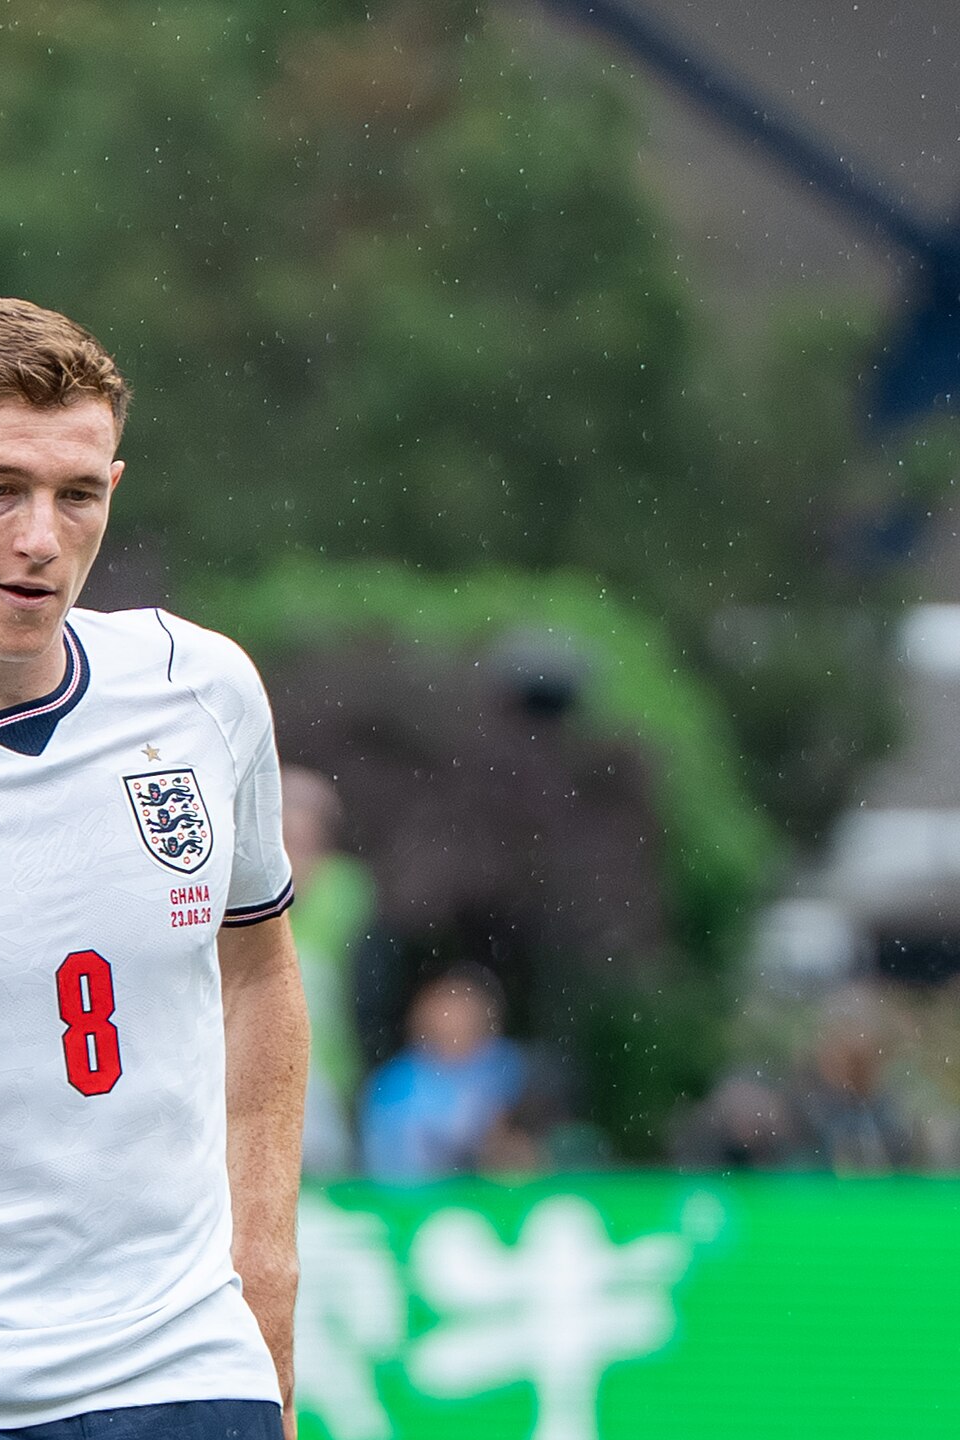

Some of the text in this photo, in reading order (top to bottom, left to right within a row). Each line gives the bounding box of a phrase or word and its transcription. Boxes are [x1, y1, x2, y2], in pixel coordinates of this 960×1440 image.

[170, 885, 210, 905] GHANA
[171, 908, 211, 928] 23.06.26
[55, 949, 123, 1097] 8
